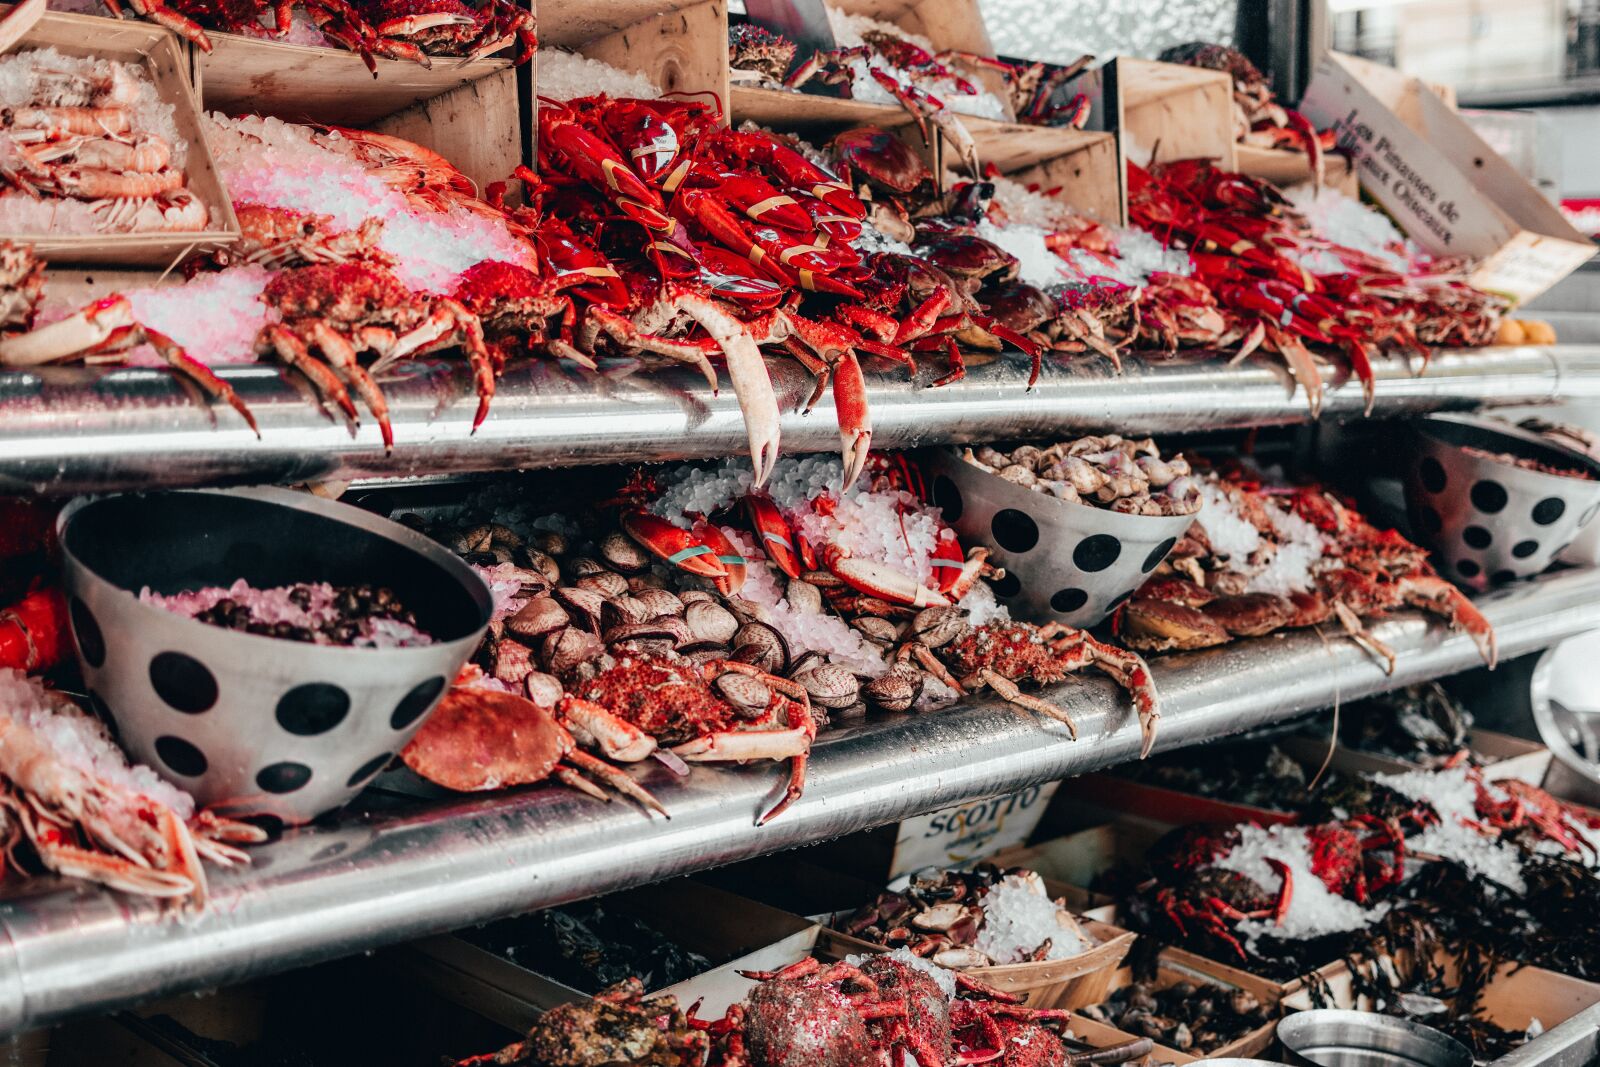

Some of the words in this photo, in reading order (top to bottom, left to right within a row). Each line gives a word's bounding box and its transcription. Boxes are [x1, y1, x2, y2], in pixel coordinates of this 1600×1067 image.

[1345, 109, 1374, 143] Les
[1374, 135, 1438, 205] Pinasses
[1438, 200, 1460, 224] de
[1362, 155, 1391, 187] aux
[1392, 179, 1454, 246] Oiseaux
[924, 784, 1042, 839] SCOTTO
